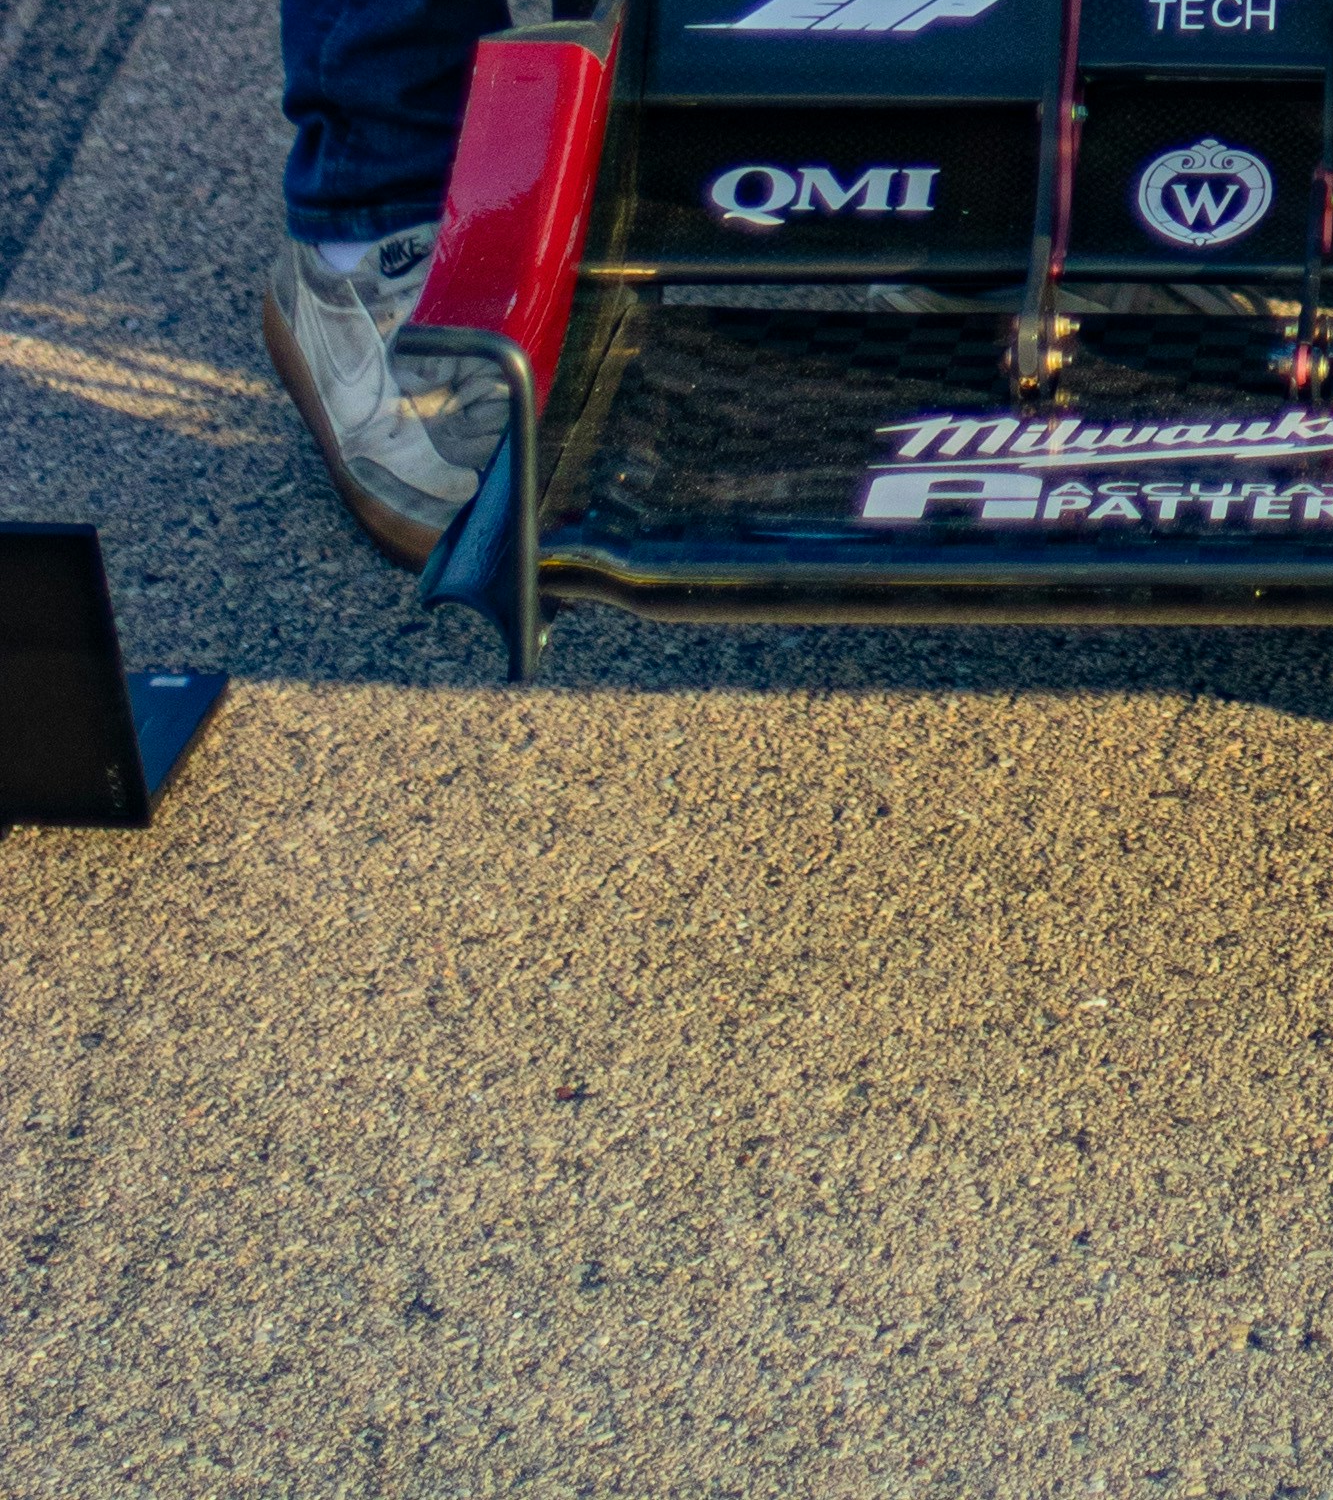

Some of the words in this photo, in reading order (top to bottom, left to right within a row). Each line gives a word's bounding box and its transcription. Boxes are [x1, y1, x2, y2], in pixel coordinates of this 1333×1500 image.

[711, 165, 941, 226] QMI
[1170, 180, 1241, 226] W
[379, 236, 422, 269] NIKE
